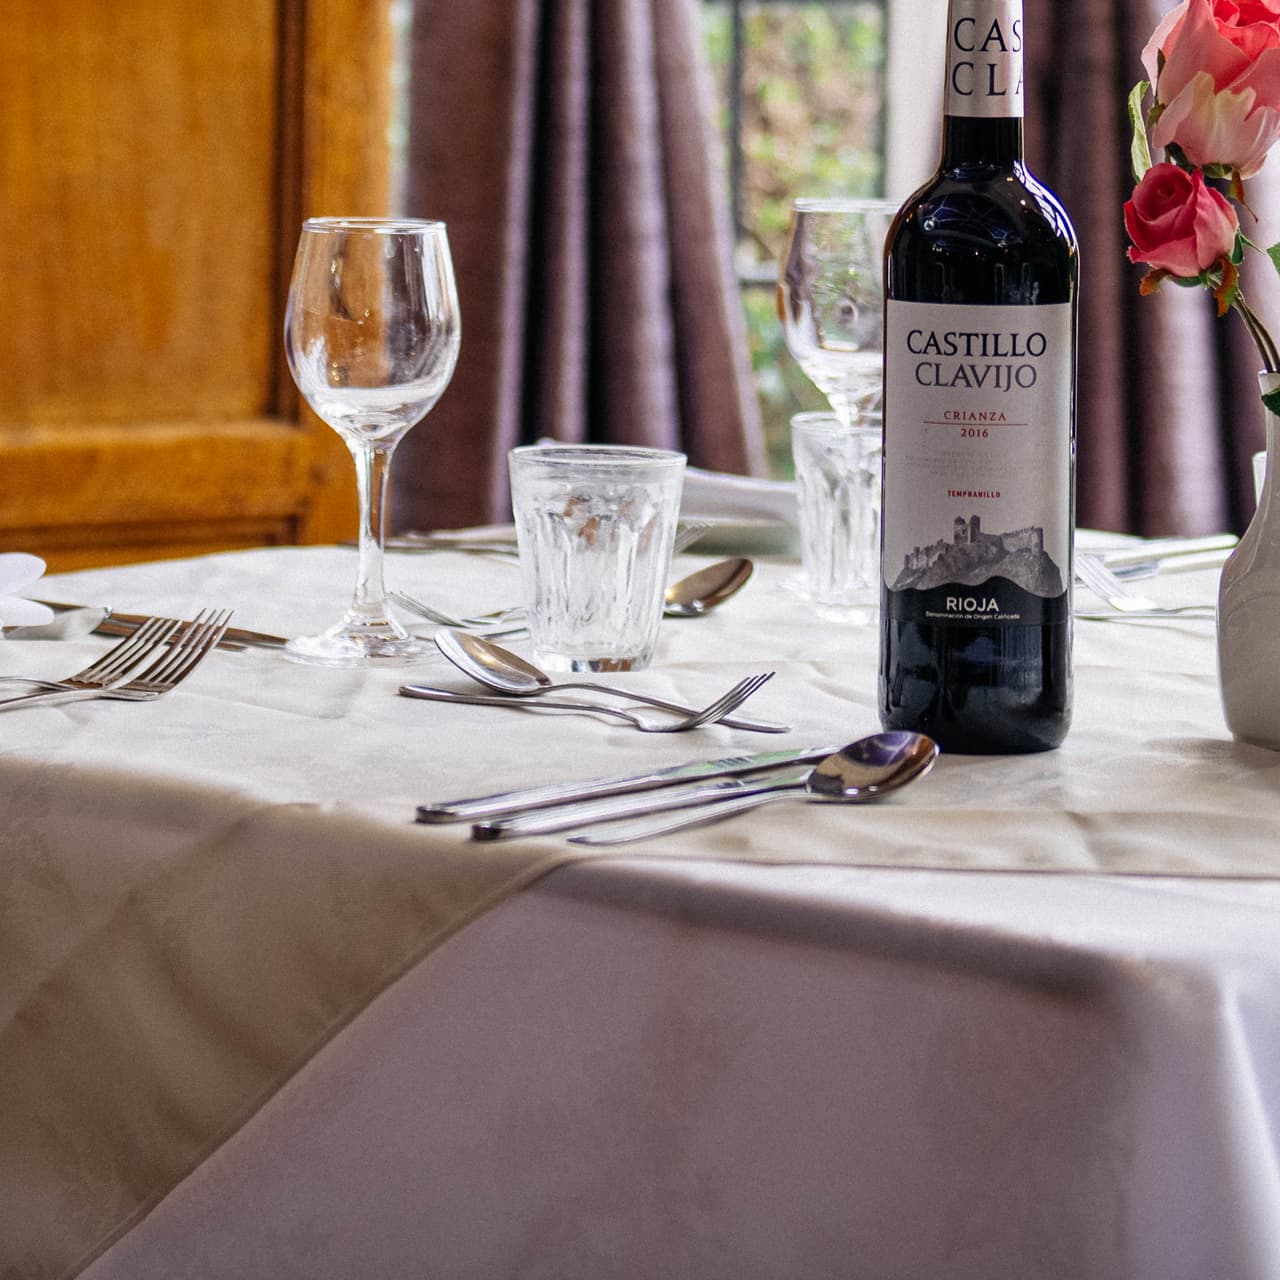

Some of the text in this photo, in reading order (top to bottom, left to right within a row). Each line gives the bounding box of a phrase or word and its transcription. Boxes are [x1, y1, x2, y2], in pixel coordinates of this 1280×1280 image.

[906, 329, 1047, 357] CASTILLO
[915, 361, 1037, 392] CLAVIJO
[943, 410, 1007, 422] CRIANZA
[960, 428, 989, 439] 2016
[947, 489, 1001, 499] TEMPRANILLO
[946, 597, 1000, 612] RIOJA
